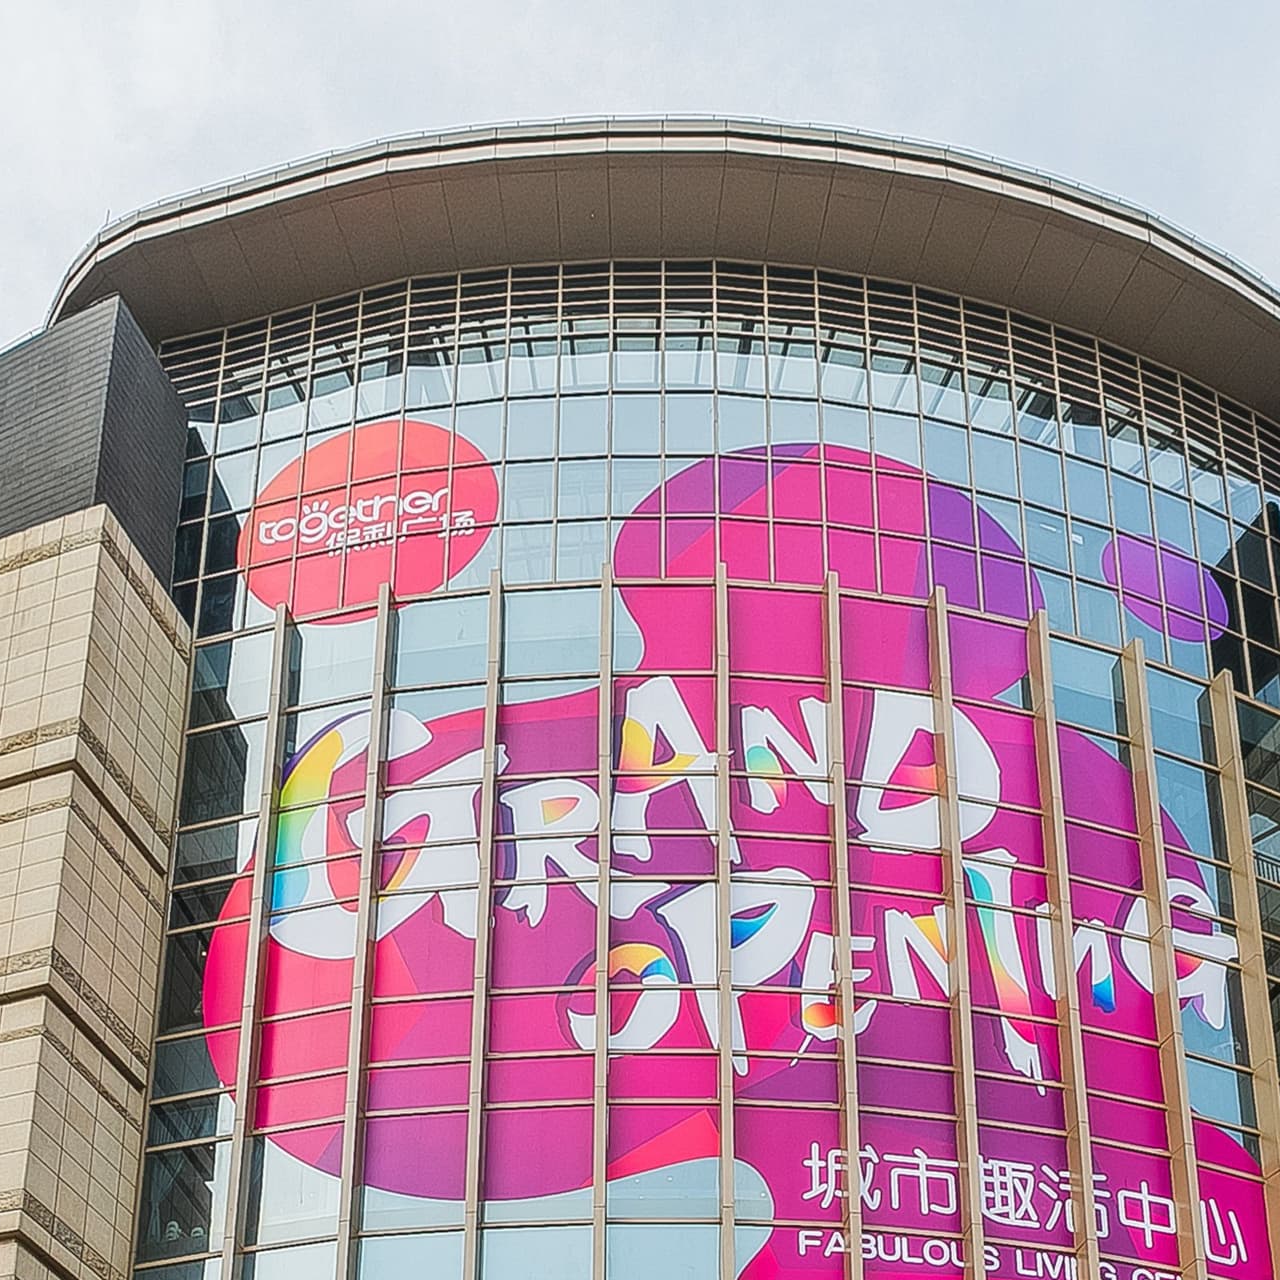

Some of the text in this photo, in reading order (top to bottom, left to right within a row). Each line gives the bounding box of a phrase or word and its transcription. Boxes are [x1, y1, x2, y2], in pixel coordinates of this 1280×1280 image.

[258, 487, 449, 545] together
[325, 509, 476, 556] 保利广场
[269, 674, 1000, 960] GRAND
[568, 845, 1239, 1096] OPENING
[802, 1141, 1247, 1267] 城市趣活中心
[798, 1230, 1001, 1272] FABULOUS
